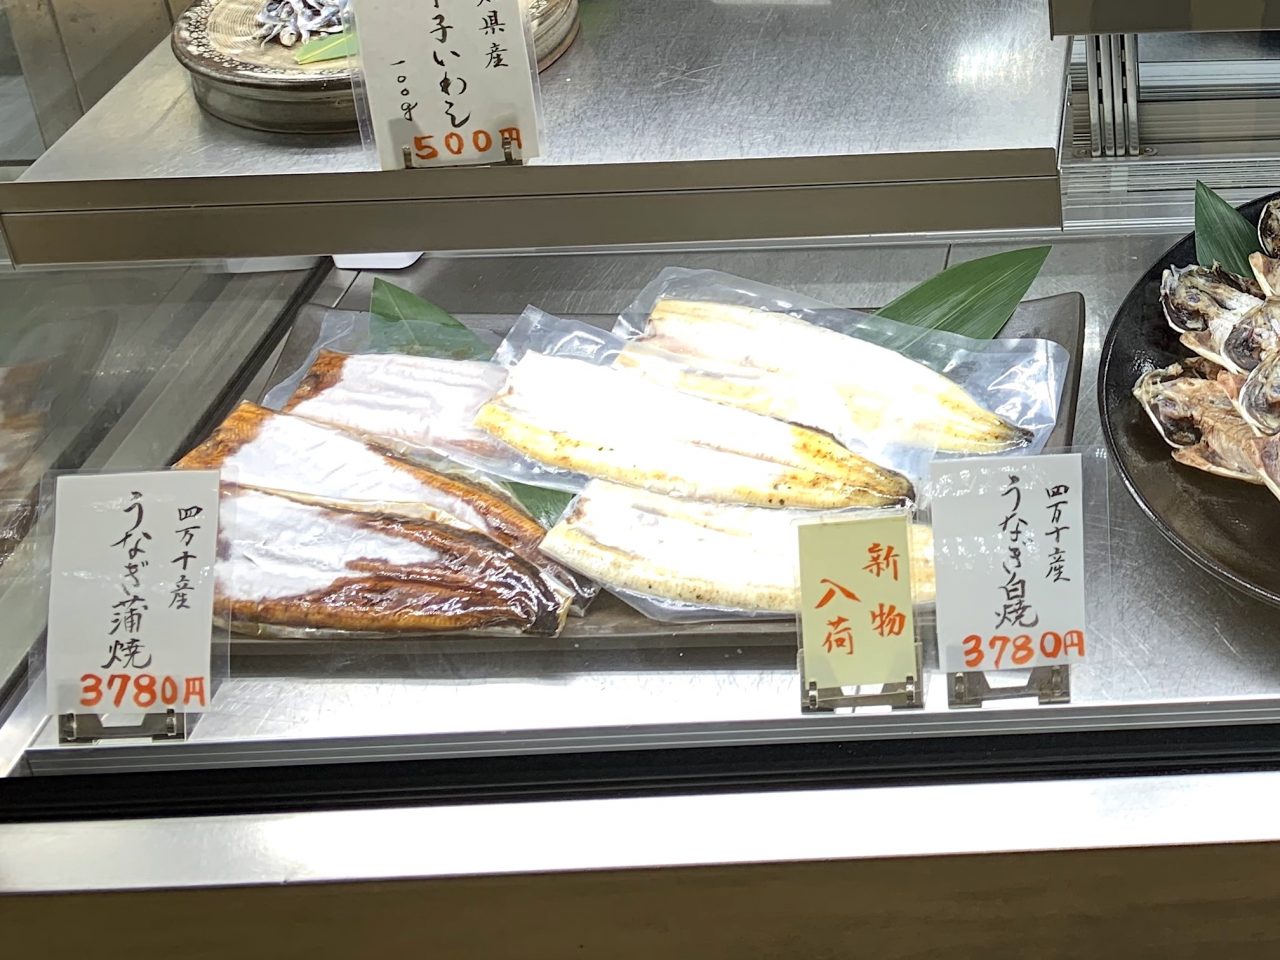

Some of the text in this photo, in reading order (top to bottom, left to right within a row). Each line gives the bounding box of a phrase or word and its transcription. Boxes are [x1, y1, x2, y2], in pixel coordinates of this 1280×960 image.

[413, 127, 524, 160] 500円
[100, 491, 153, 670] うなぎ蒲焼
[168, 504, 204, 610] 四万十産
[994, 474, 1039, 630] うなぎ白焼
[1044, 483, 1072, 584] 四万十産
[814, 577, 862, 656] 入荷
[861, 542, 907, 638] 新物
[79, 672, 207, 709] 3780円
[961, 629, 1087, 670] 3780円
